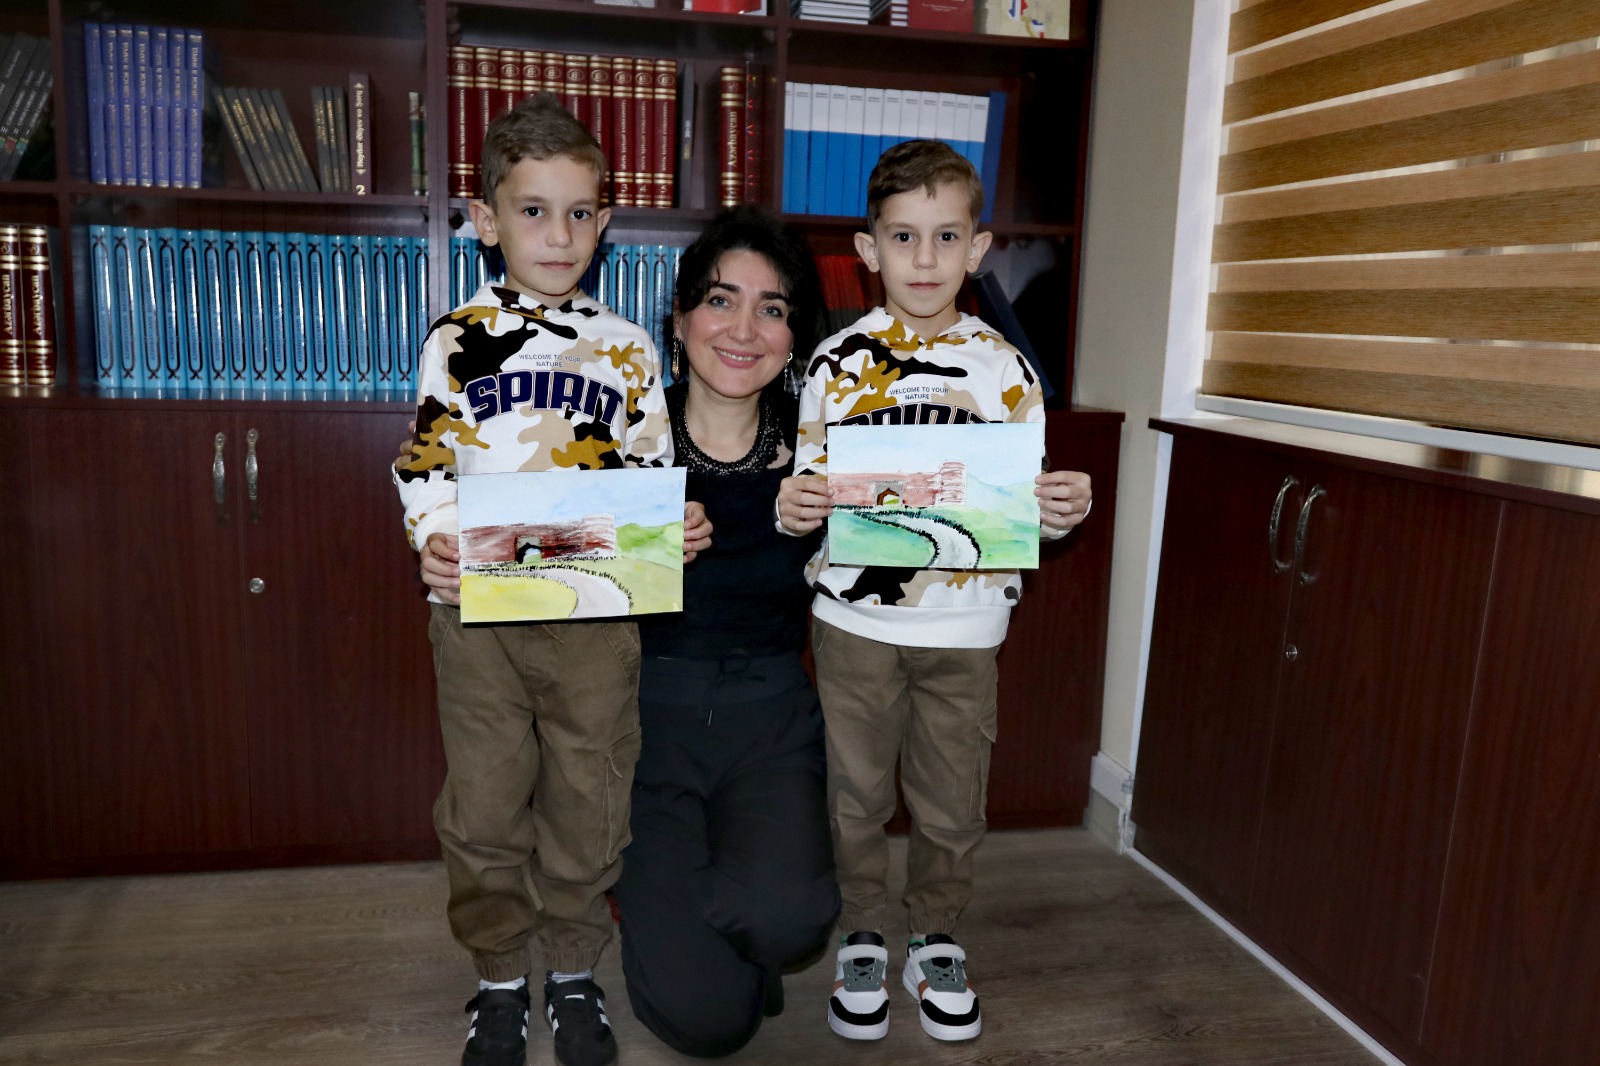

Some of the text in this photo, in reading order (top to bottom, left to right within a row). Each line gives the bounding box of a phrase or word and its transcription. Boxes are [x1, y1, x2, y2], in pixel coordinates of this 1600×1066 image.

[727, 111, 738, 167] Azərbaycan
[356, 184, 366, 195] 2
[2, 274, 13, 336] Azərbaycan
[31, 275, 42, 336] Azərbaycan
[465, 370, 624, 427] SPIRIT
[890, 386, 920, 395] WELCOME
